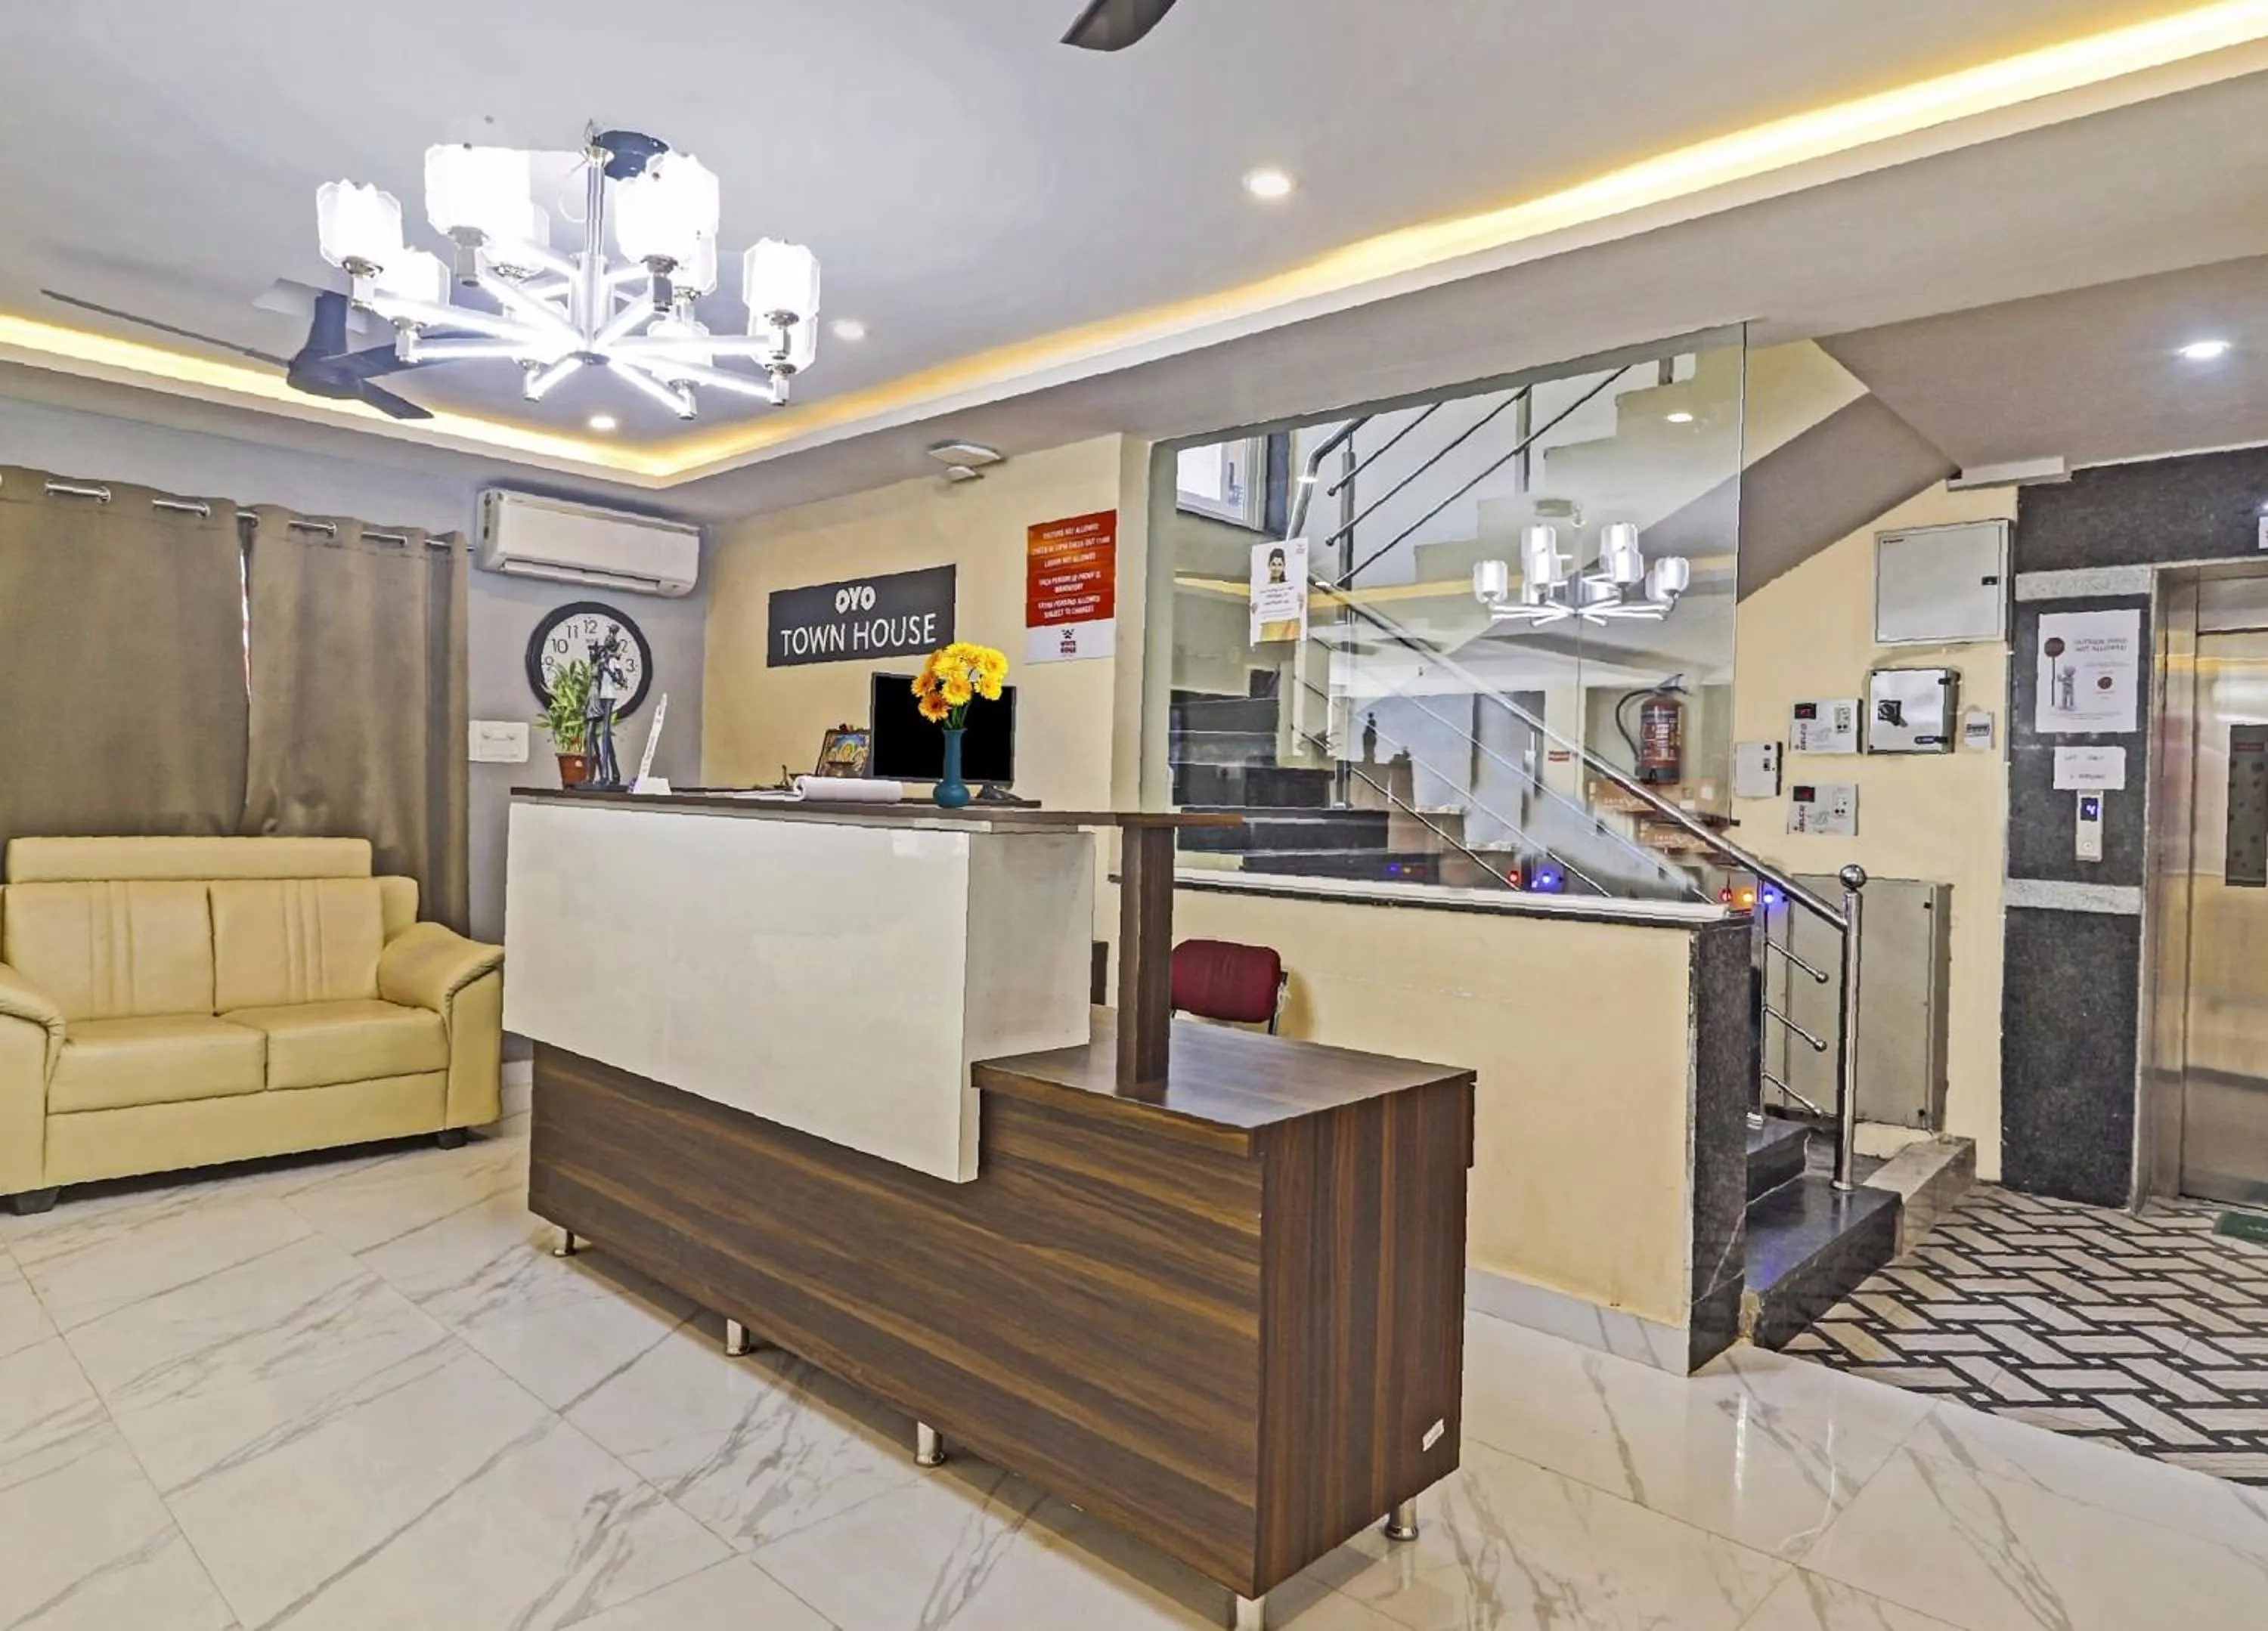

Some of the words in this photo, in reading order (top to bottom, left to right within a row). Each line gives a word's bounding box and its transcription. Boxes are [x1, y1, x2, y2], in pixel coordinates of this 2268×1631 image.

[835, 586, 876, 614] OYO
[567, 625, 579, 639] 11
[583, 619, 598, 634] 12
[781, 623, 845, 656] TOWN
[854, 613, 936, 650] HOUSE
[553, 639, 569, 654] 10
[625, 658, 635, 673] 3
